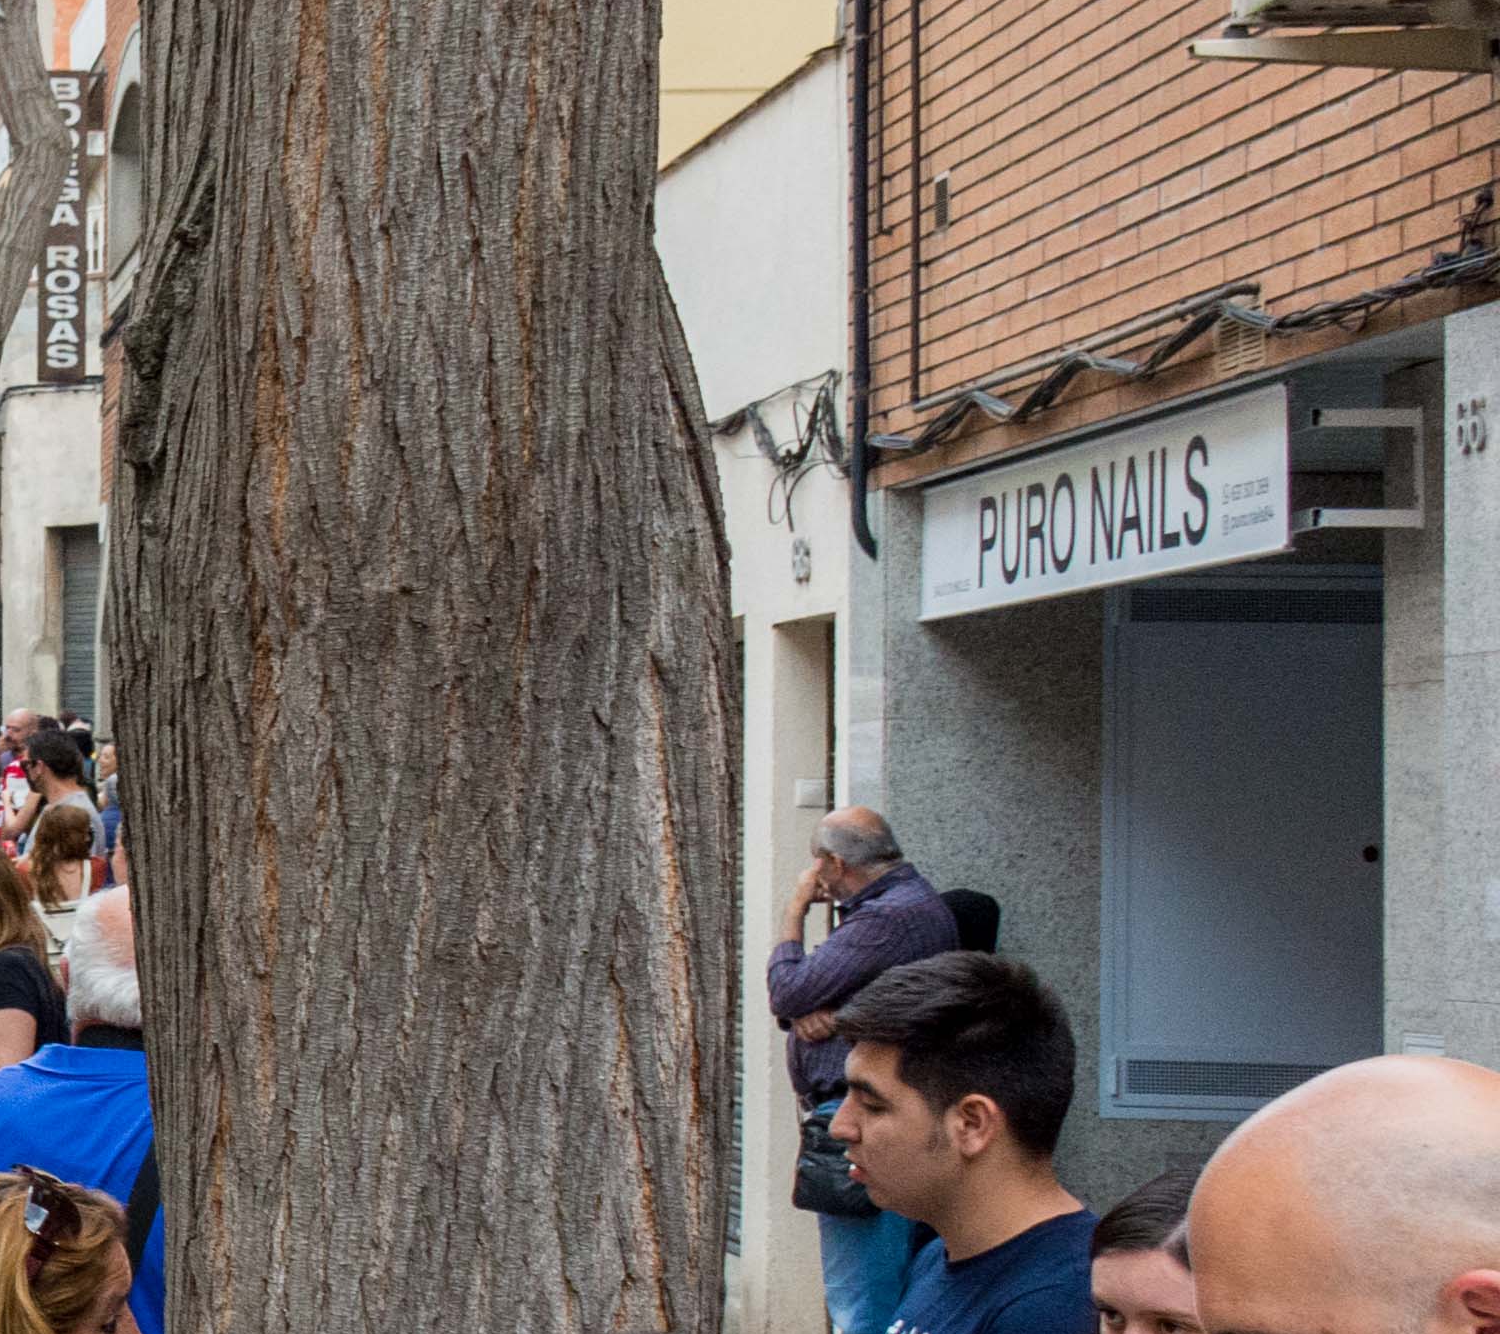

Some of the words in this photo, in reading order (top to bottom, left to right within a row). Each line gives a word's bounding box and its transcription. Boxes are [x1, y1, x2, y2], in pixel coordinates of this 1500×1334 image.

[45, 245, 81, 368] ROSAS
[978, 472, 1076, 589] PURO
[1089, 434, 1210, 566] NAILS
